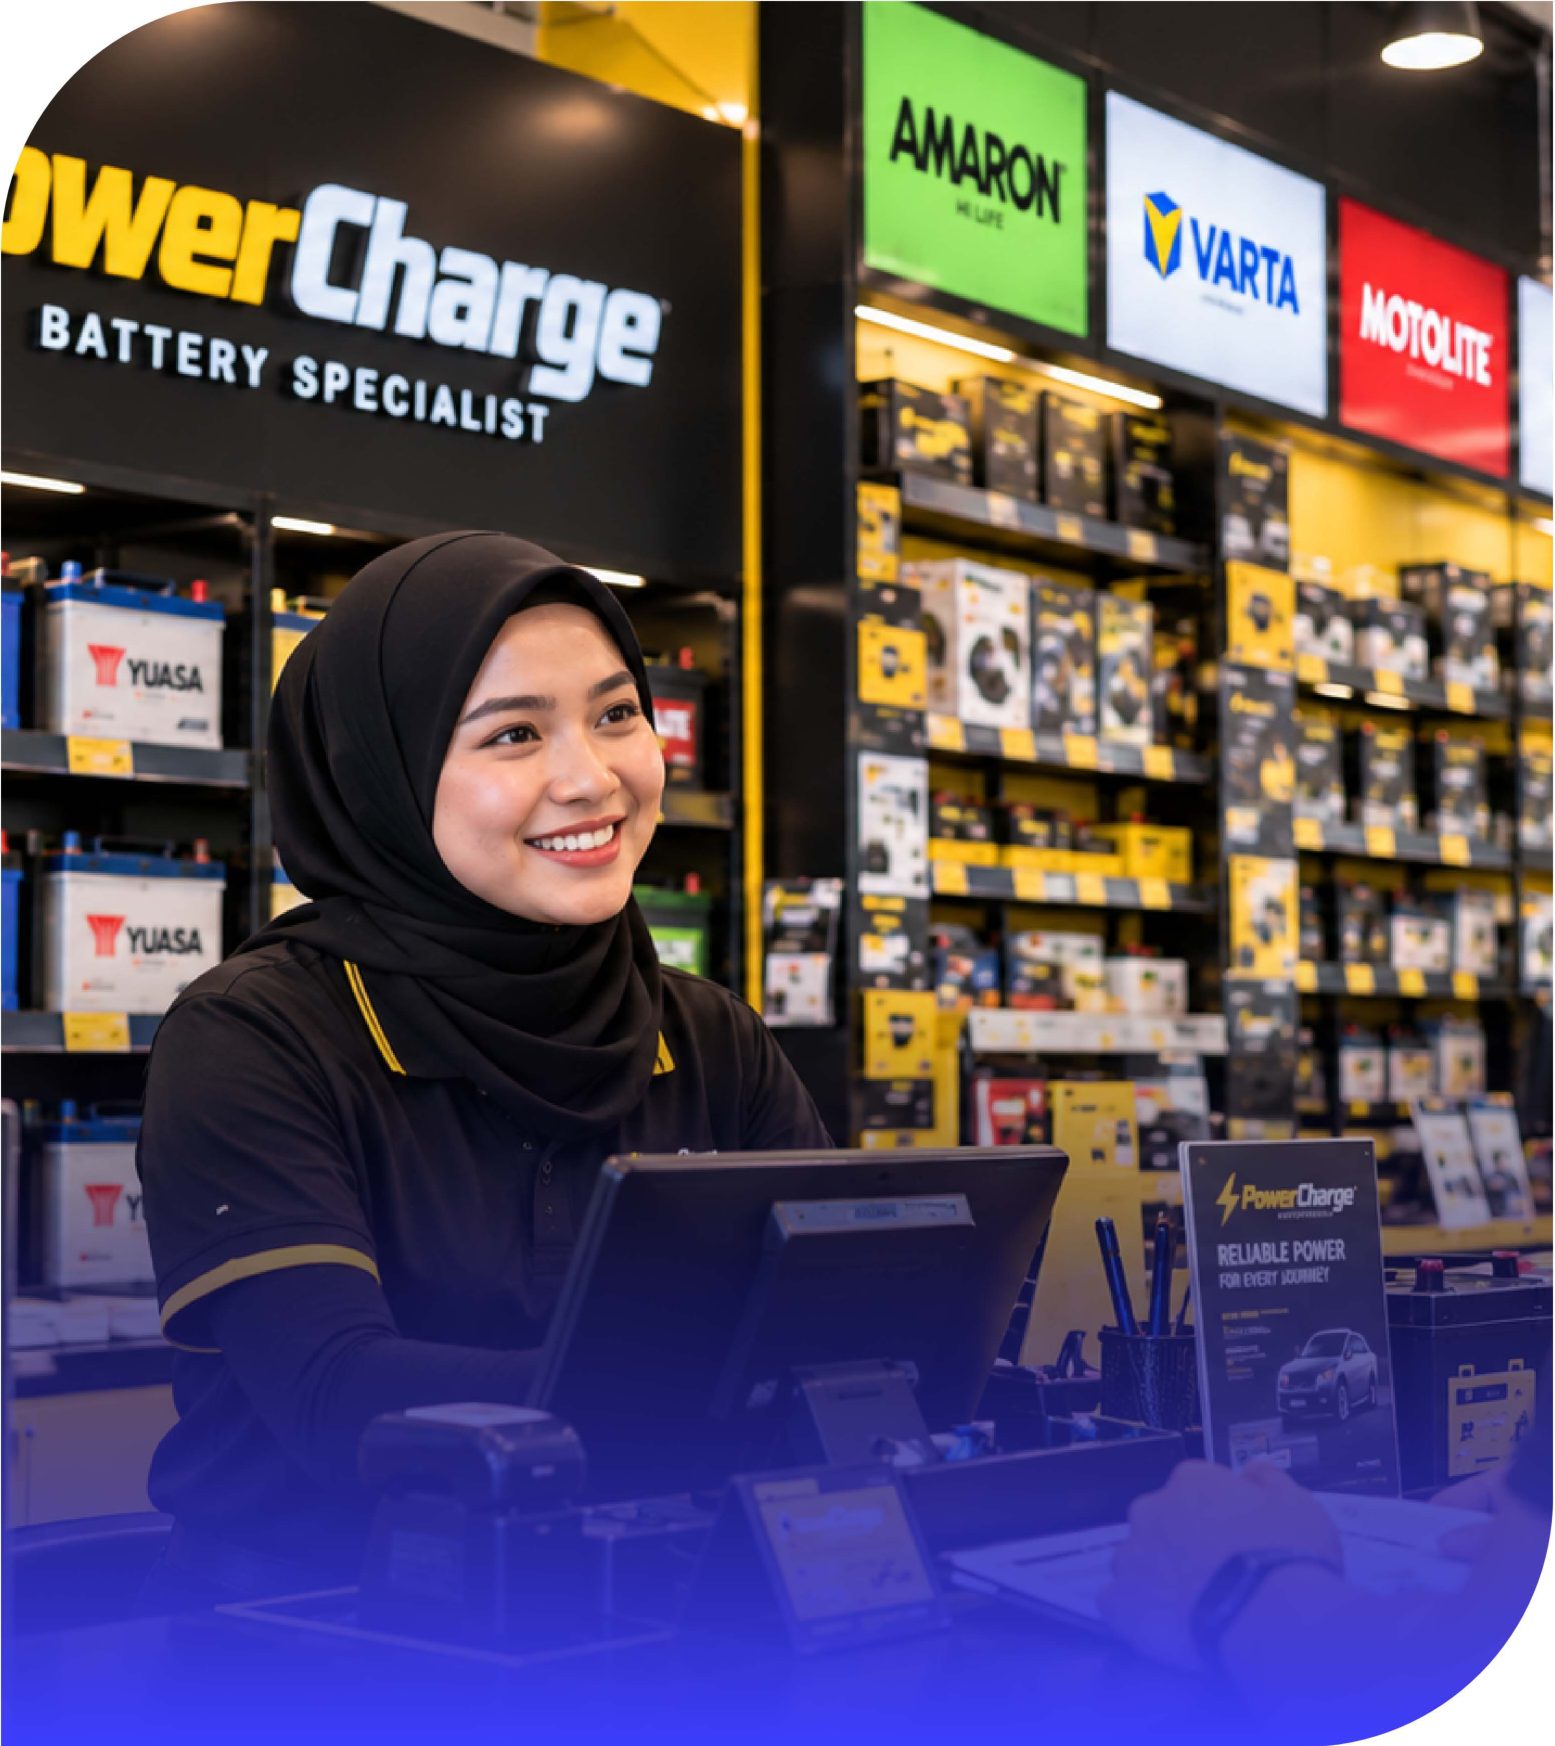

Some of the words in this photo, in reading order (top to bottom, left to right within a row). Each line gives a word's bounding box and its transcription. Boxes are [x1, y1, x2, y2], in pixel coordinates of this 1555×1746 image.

[889, 95, 1061, 224] AMARON
[1190, 215, 1300, 316] VARTA
[1359, 281, 1493, 388] MOTOLITE
[41, 304, 269, 388] BATTERY
[292, 354, 550, 444] SPECIALIST
[127, 658, 204, 693] YUASA
[126, 926, 203, 955] YUASA
[1241, 1183, 1354, 1213] PowerCharge
[1217, 1241, 1290, 1267] RELIABLE
[1293, 1238, 1346, 1262] POWER
